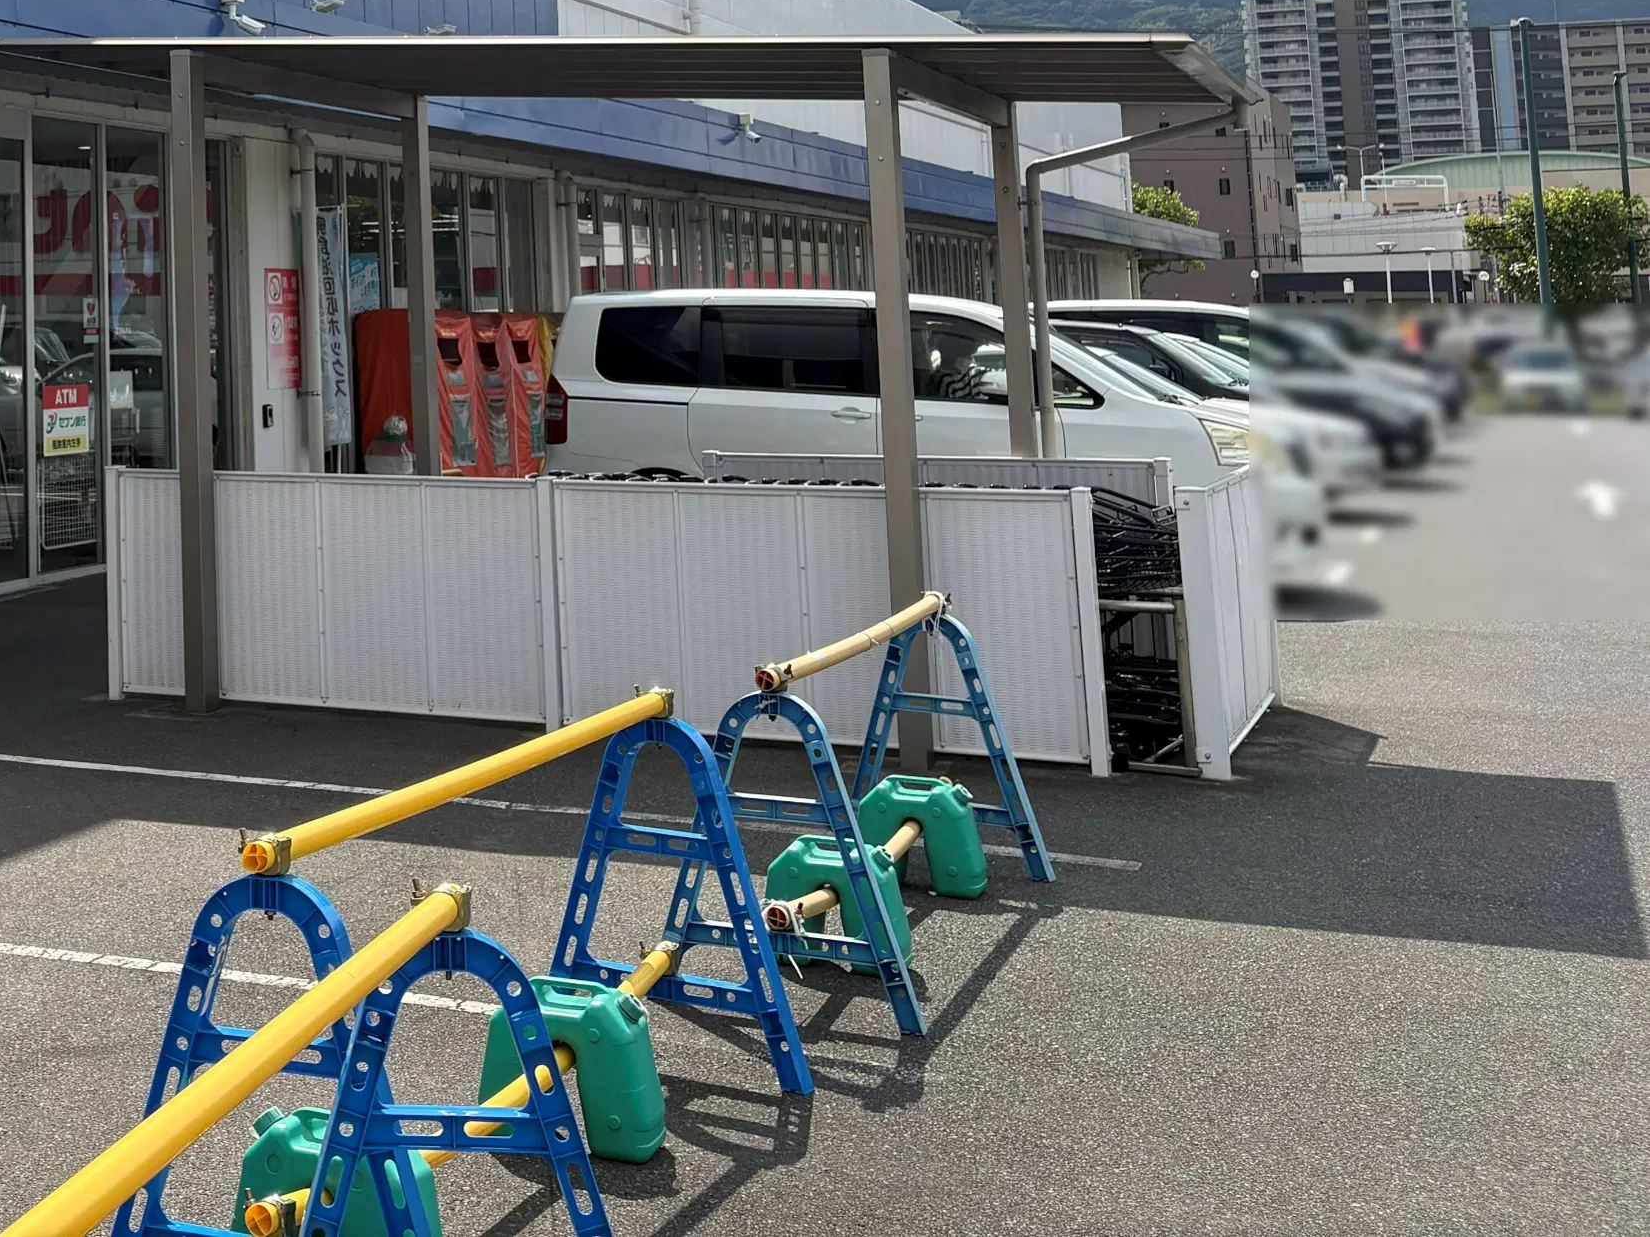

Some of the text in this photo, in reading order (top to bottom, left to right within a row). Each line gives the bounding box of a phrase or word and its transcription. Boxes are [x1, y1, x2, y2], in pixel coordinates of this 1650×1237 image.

[55, 388, 77, 405] ATM
[59, 415, 86, 428] セブン銀行
